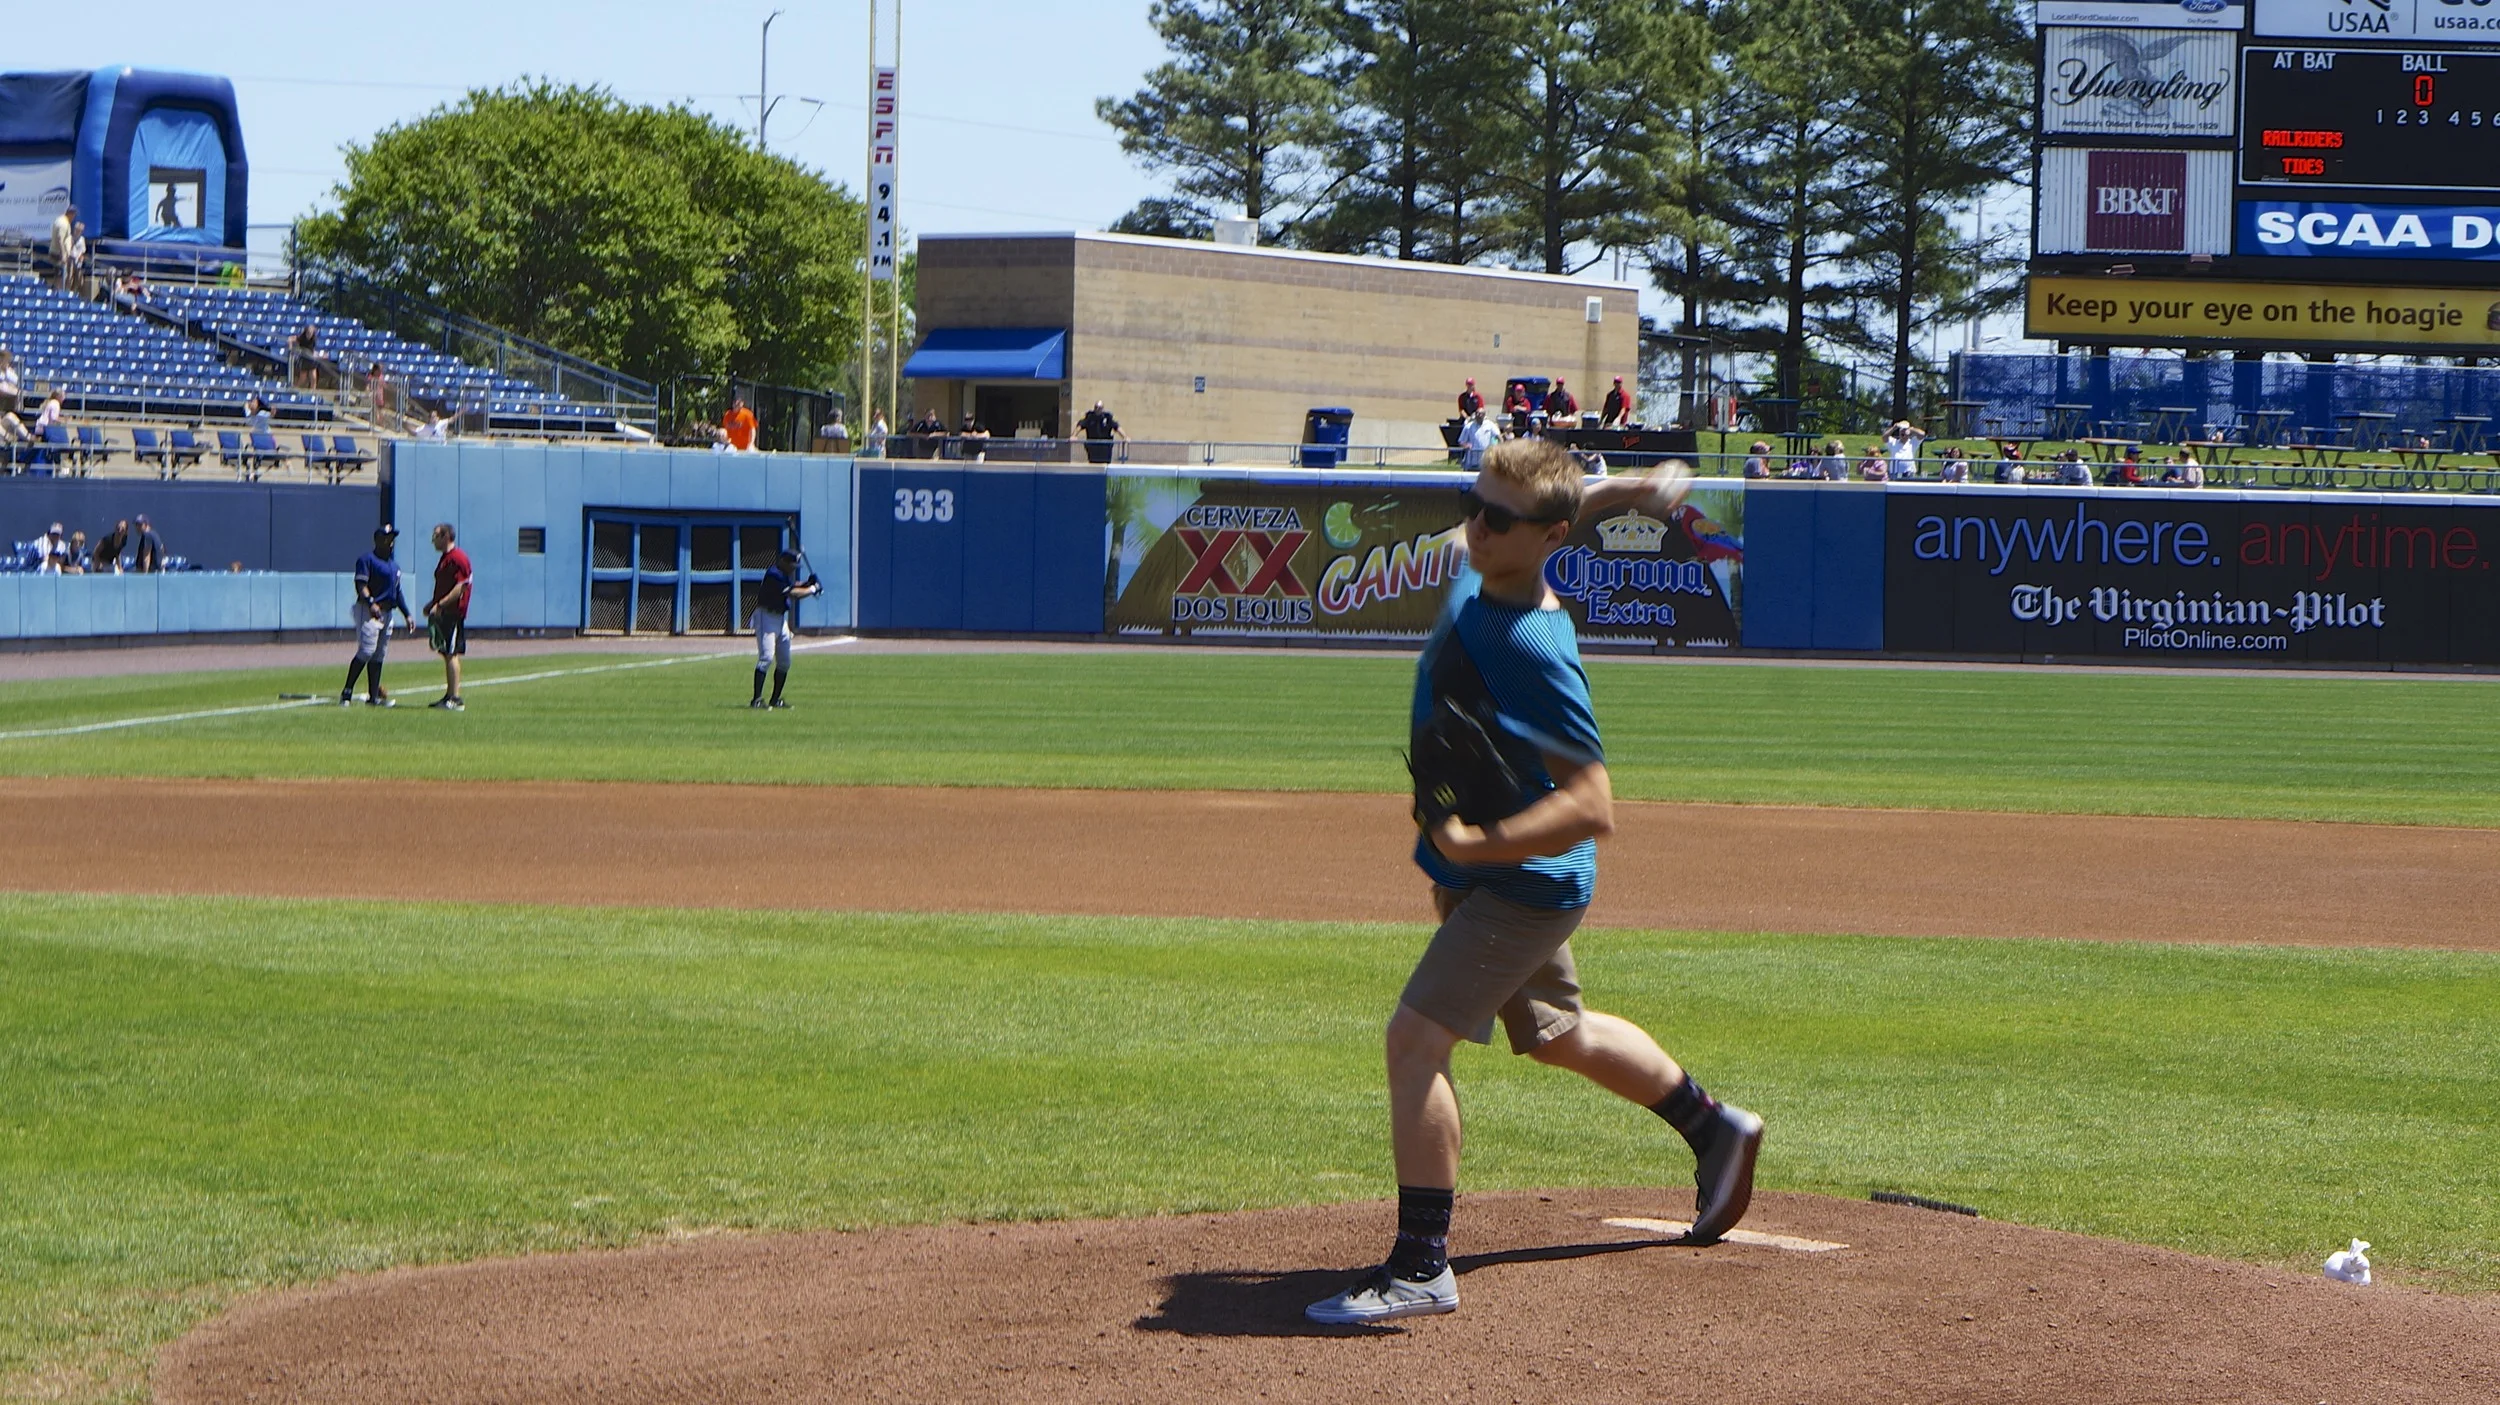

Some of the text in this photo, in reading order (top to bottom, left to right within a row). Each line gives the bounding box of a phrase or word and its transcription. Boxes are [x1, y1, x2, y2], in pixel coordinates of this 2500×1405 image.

[2051, 13, 2139, 22] LocalFordDealer.com
[2328, 12, 2390, 33] USAA
[2273, 52, 2336, 70] AT BAT
[2402, 54, 2447, 72] BALL
[2050, 58, 2231, 110] Yuengling
[2415, 75, 2433, 106] 0
[2062, 119, 2103, 128] America's
[2105, 120, 2132, 128] Oldest
[2135, 121, 2169, 130] Brewery
[2172, 121, 2195, 130] Since
[2376, 109, 2383, 124] 1
[2396, 109, 2408, 124] 2
[2418, 110, 2429, 124] 3
[2449, 111, 2460, 126] 4
[2471, 111, 2482, 126] 5
[2262, 130, 2343, 147] RAILRIDERS
[2281, 157, 2324, 174] TIDES
[2095, 186, 2178, 216] BB&T
[2257, 211, 2431, 249] SCAA
[873, 255, 892, 267] FM
[2047, 292, 2463, 331] Keep your eye on the hoagie
[894, 488, 954, 522] 333
[1185, 505, 1303, 530] CERVEZA
[1913, 501, 2489, 582] anywhere. anytime.
[1173, 527, 1312, 598] XX
[1542, 544, 1706, 602] Corona
[1172, 596, 1314, 625] DOS EQUIS
[1587, 590, 1676, 627] Extra
[2010, 582, 2386, 634] The Virginian-Pilot
[2124, 627, 2287, 652] PilotOnline.com
